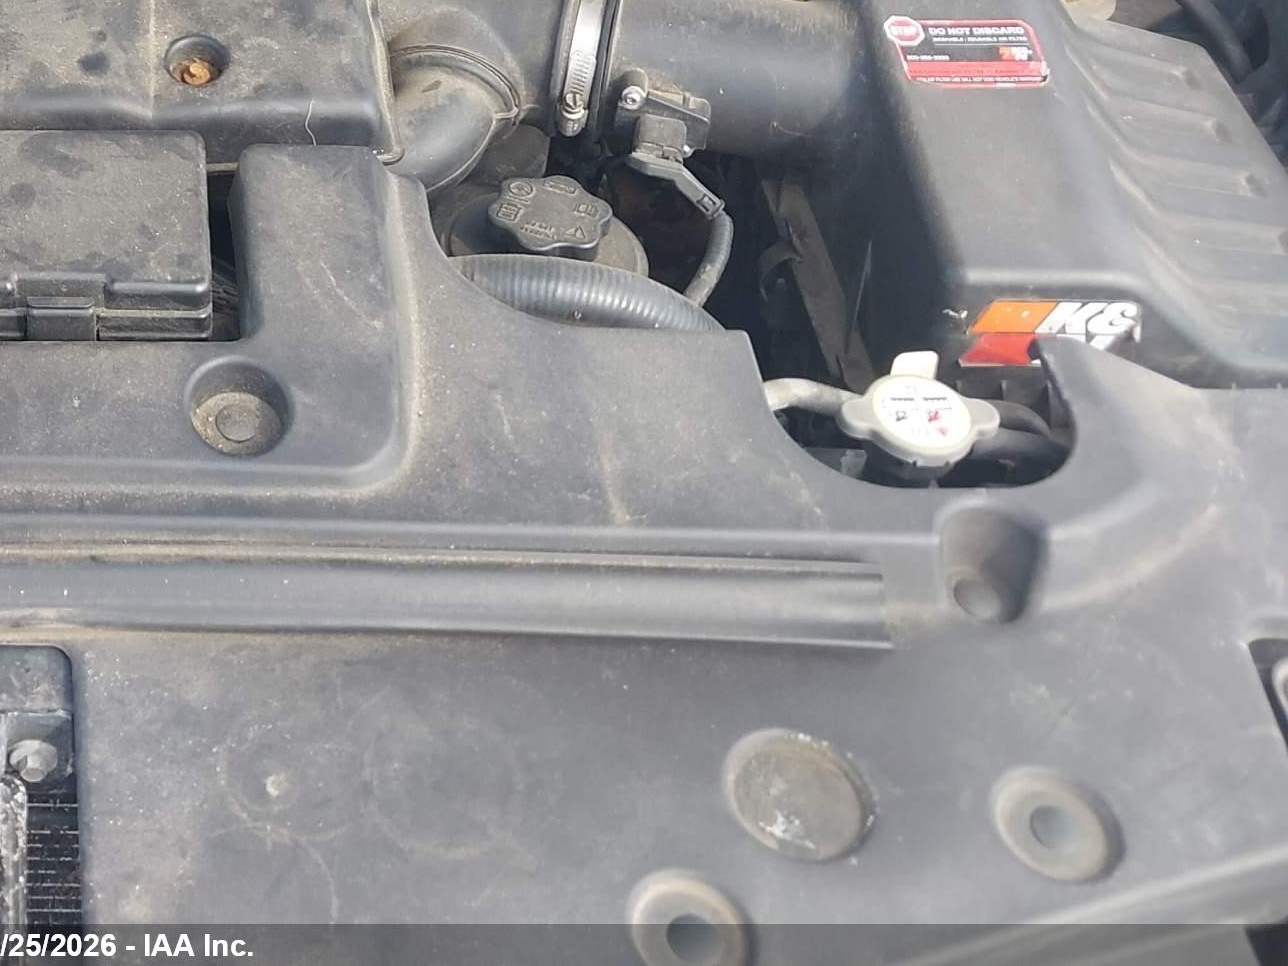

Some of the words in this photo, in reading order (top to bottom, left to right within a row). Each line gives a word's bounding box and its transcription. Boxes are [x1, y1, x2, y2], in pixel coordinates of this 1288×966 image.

[928, 27, 946, 35] DO
[947, 27, 971, 35] NOT
[972, 26, 1025, 35] DISCARD
